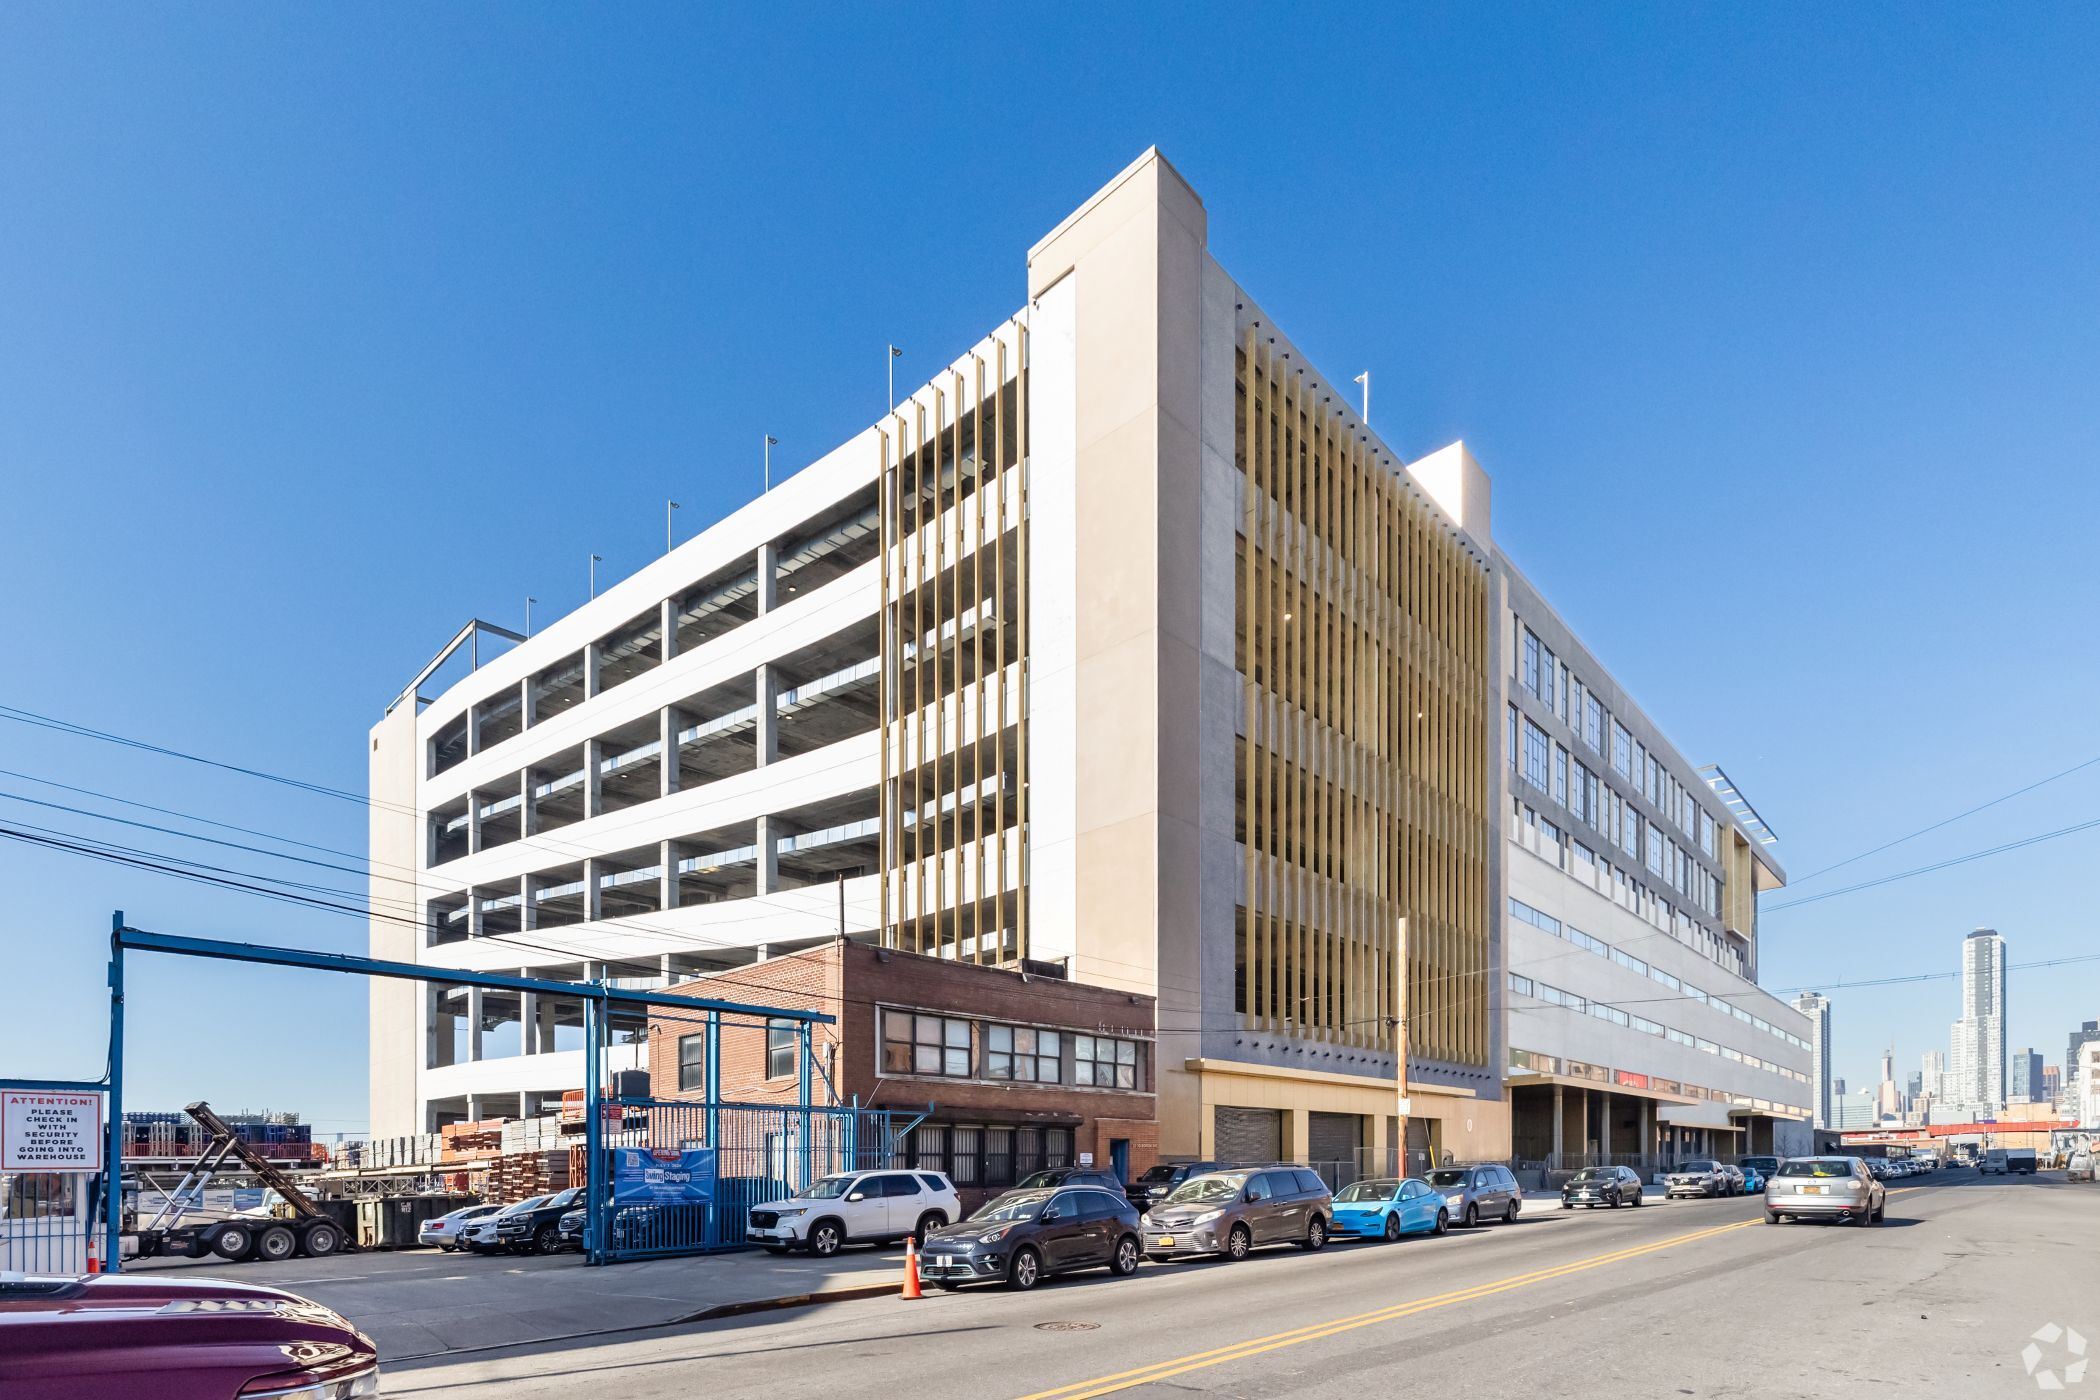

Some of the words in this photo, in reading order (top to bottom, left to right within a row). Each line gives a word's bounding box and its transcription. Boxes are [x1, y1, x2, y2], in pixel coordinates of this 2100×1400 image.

[11, 1097, 92, 1105] ATTENTION!
[645, 1171, 663, 1182] Swing
[664, 1171, 690, 1182] Staging
